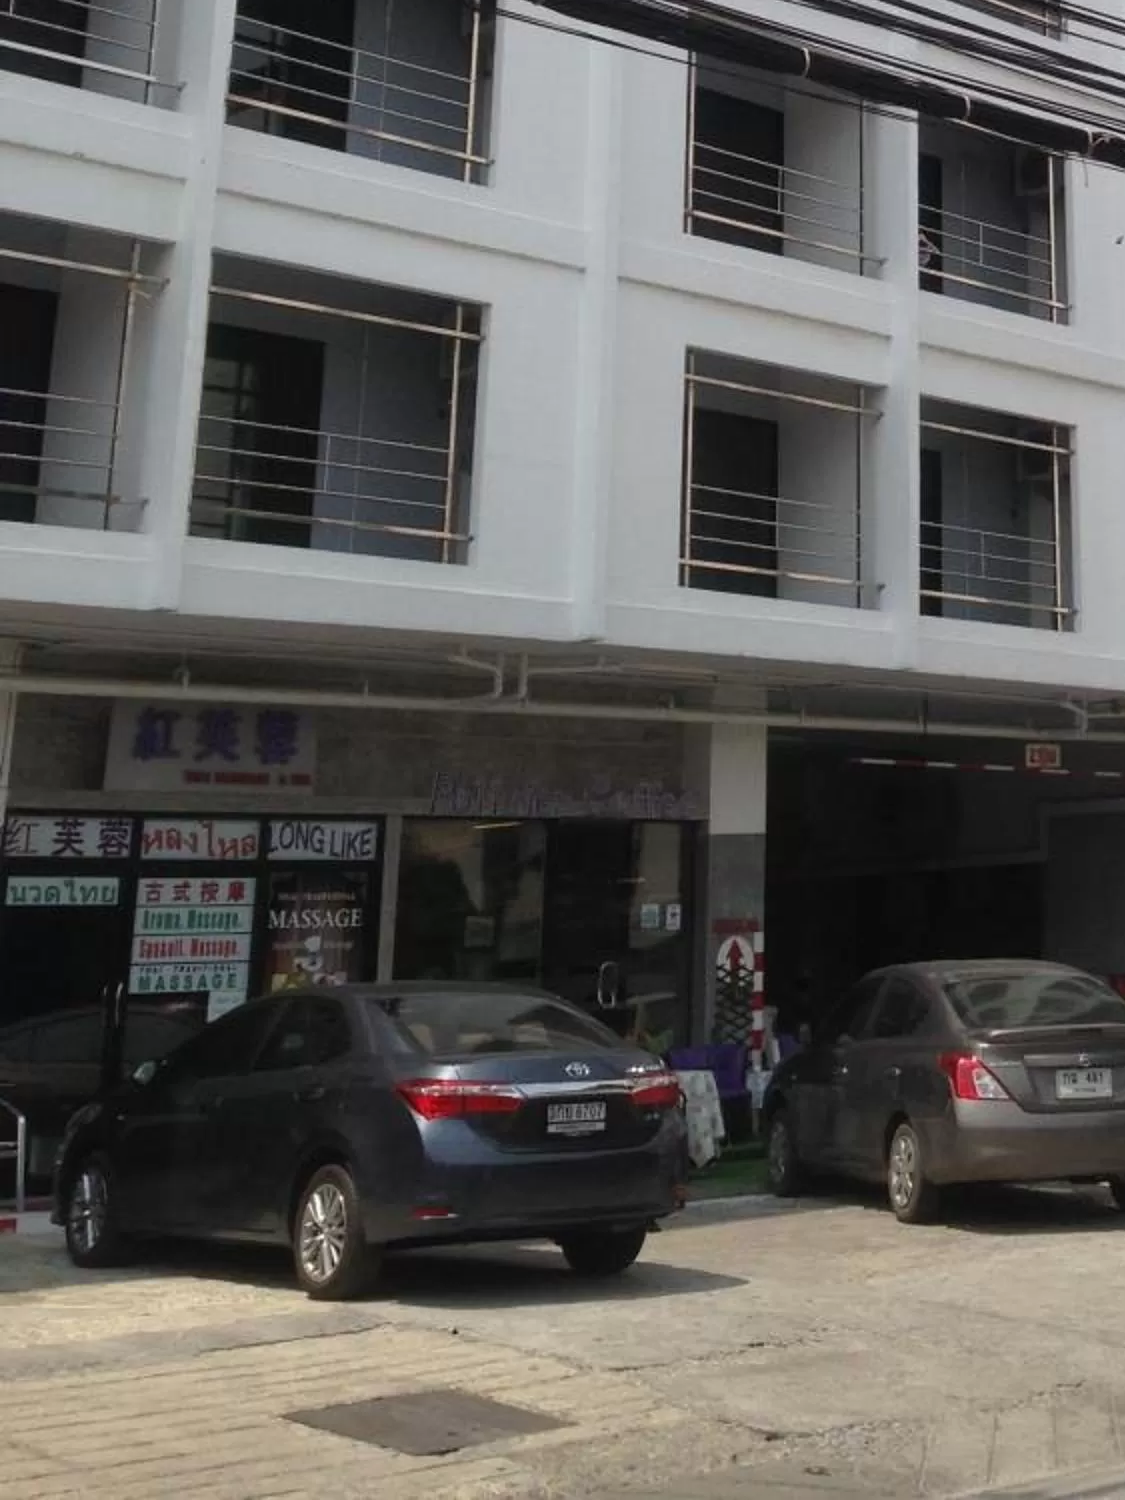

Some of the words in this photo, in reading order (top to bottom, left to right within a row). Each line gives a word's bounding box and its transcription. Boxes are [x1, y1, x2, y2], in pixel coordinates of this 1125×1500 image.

[267, 820, 325, 853] LONG
[330, 828, 374, 858] LIKE
[268, 908, 363, 929] MASSAGE
[137, 973, 238, 992] MASSAGE
